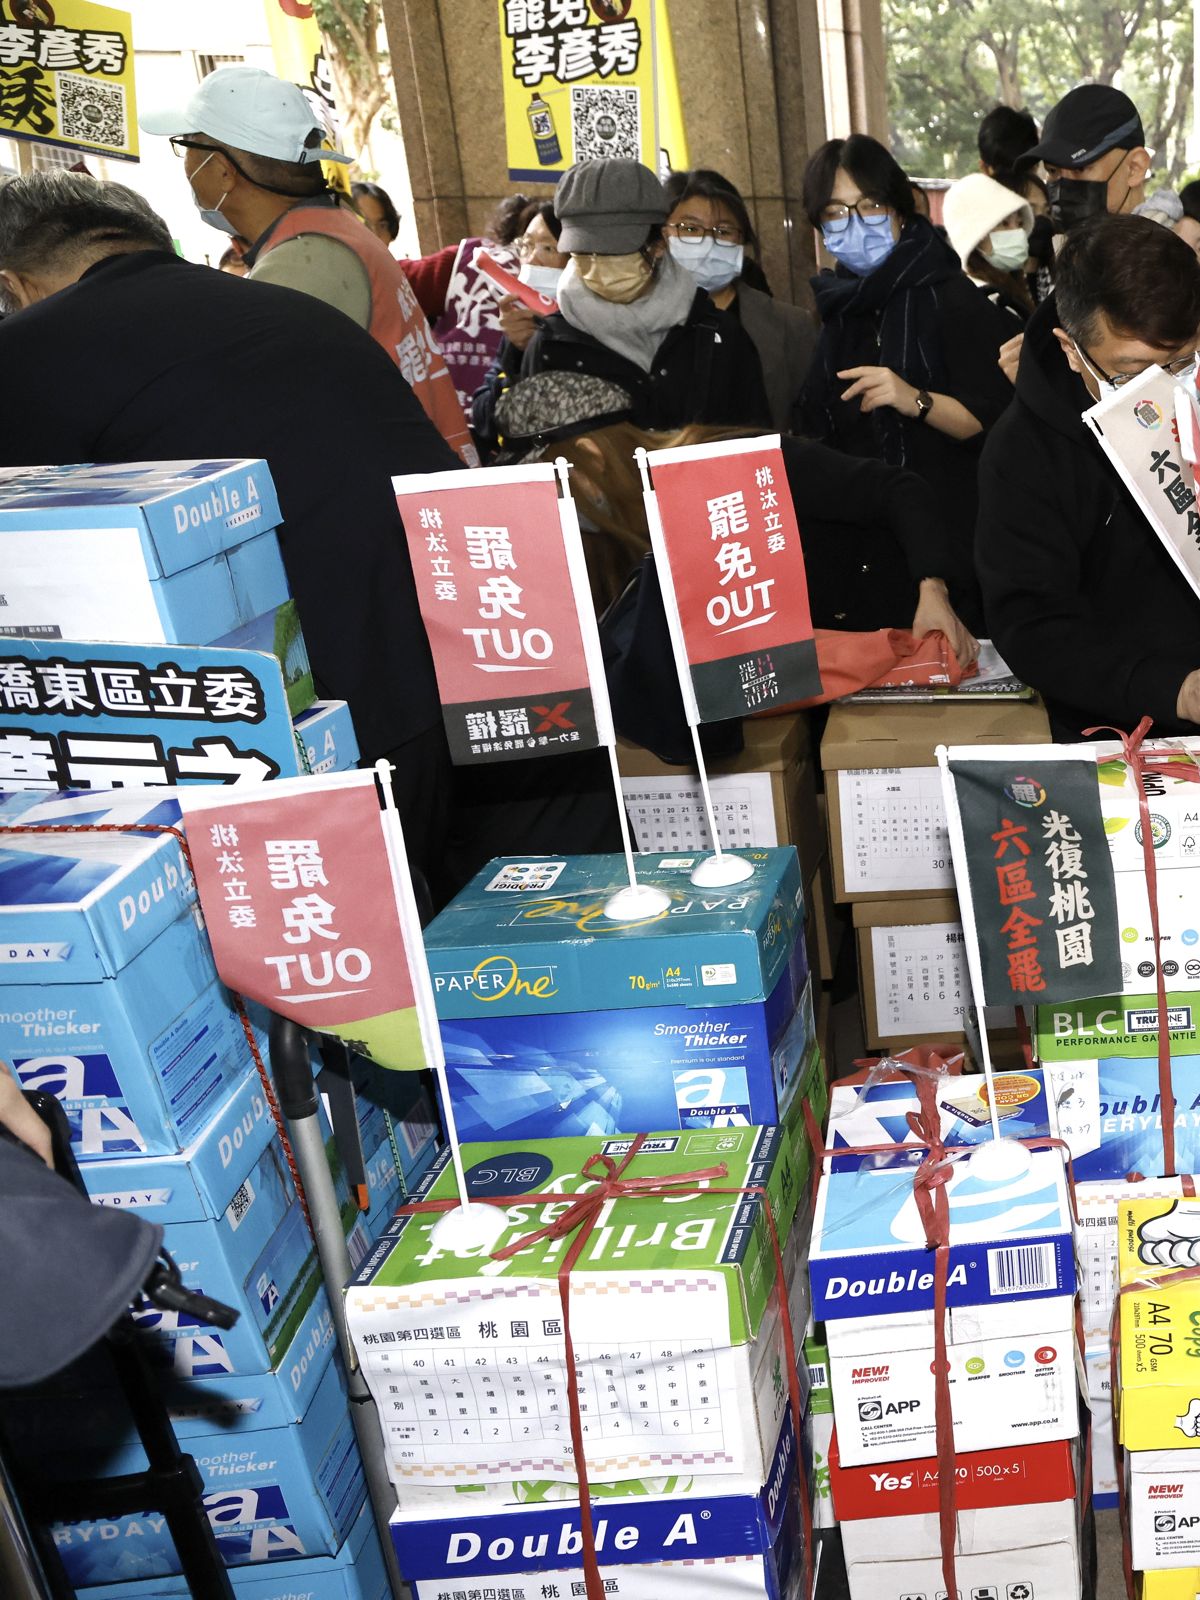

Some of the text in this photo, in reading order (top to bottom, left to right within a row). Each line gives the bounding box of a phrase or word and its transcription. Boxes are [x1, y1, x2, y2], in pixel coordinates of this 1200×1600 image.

[0, 24, 125, 71] 李彥秀
[515, 21, 640, 85] 李彥秀
[173, 475, 260, 534] Double A
[754, 466, 786, 554] 桃汰立委
[225, 506, 262, 528] EVERYDAY
[706, 491, 757, 586] 罷免
[706, 580, 775, 627] OUT
[1142, 771, 1167, 796] UPM
[1184, 813, 1199, 822] A4
[932, 860, 945, 869] 30
[1041, 809, 1096, 969] 光復桃園
[991, 818, 1046, 993] 六區全罷
[666, 967, 681, 977] A4
[0, 1007, 77, 1023] moother
[1054, 1010, 1118, 1037] BLC
[21, 1020, 102, 1037] Thicker
[653, 1021, 730, 1036] Smoother
[684, 1033, 747, 1047] Thicker
[1056, 1035, 1137, 1047] PERFORMANCE
[671, 1057, 698, 1065] Premium
[690, 1108, 726, 1117] Double
[825, 1264, 968, 1300] Double A
[1147, 1302, 1171, 1326] A4
[362, 1325, 462, 1345] 桃園第四選區
[1135, 1334, 1146, 1349] 500
[1149, 1332, 1174, 1356] 70
[443, 1359, 455, 1367] 41
[475, 1358, 487, 1366] 42
[506, 1357, 518, 1365] 43
[660, 1350, 673, 1358] 48
[851, 1365, 890, 1379] NEW!
[851, 1375, 890, 1385] IMPROVED!
[968, 1374, 991, 1382] SHARPER
[666, 1365, 679, 1406] 文中里
[696, 1362, 709, 1404] 中泰里
[885, 1399, 921, 1415] APP
[1011, 1417, 1059, 1429] www.app.co.id
[207, 1458, 278, 1477] Thicker
[768, 1437, 791, 1520] Double
[869, 1464, 1002, 1492] Yes 500
[1148, 1484, 1184, 1494] NEW!
[446, 1513, 698, 1565] Double A
